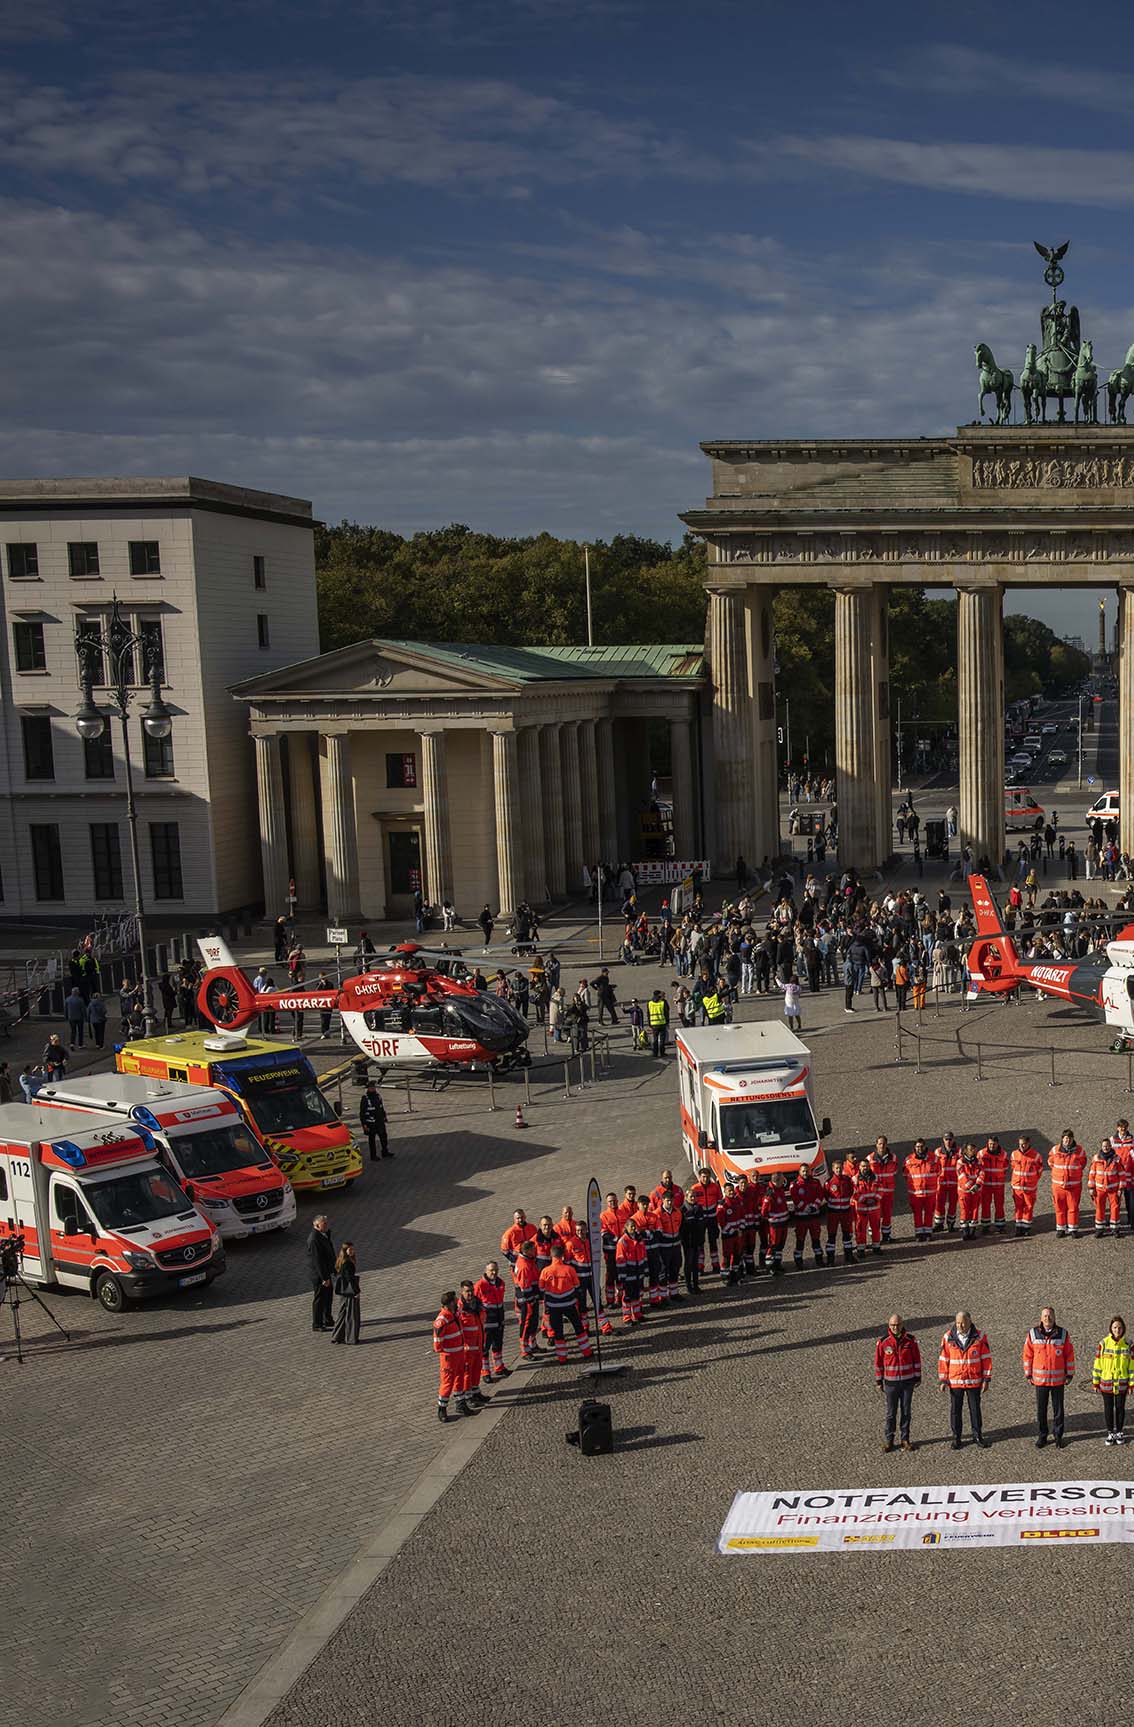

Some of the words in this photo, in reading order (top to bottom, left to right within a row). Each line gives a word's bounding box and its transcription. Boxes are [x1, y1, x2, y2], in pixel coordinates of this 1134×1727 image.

[1030, 966, 1070, 983] NOTARZT
[279, 998, 332, 1008] NOTARZT
[372, 1040, 400, 1056] DRF
[248, 1069, 300, 1083] FEUERWEHR
[730, 1091, 795, 1102] RETTUNGSDIENST
[11, 1161, 31, 1177] 112
[777, 1511, 969, 1526] Finanzierung
[1023, 1529, 1096, 1538] DLRG
